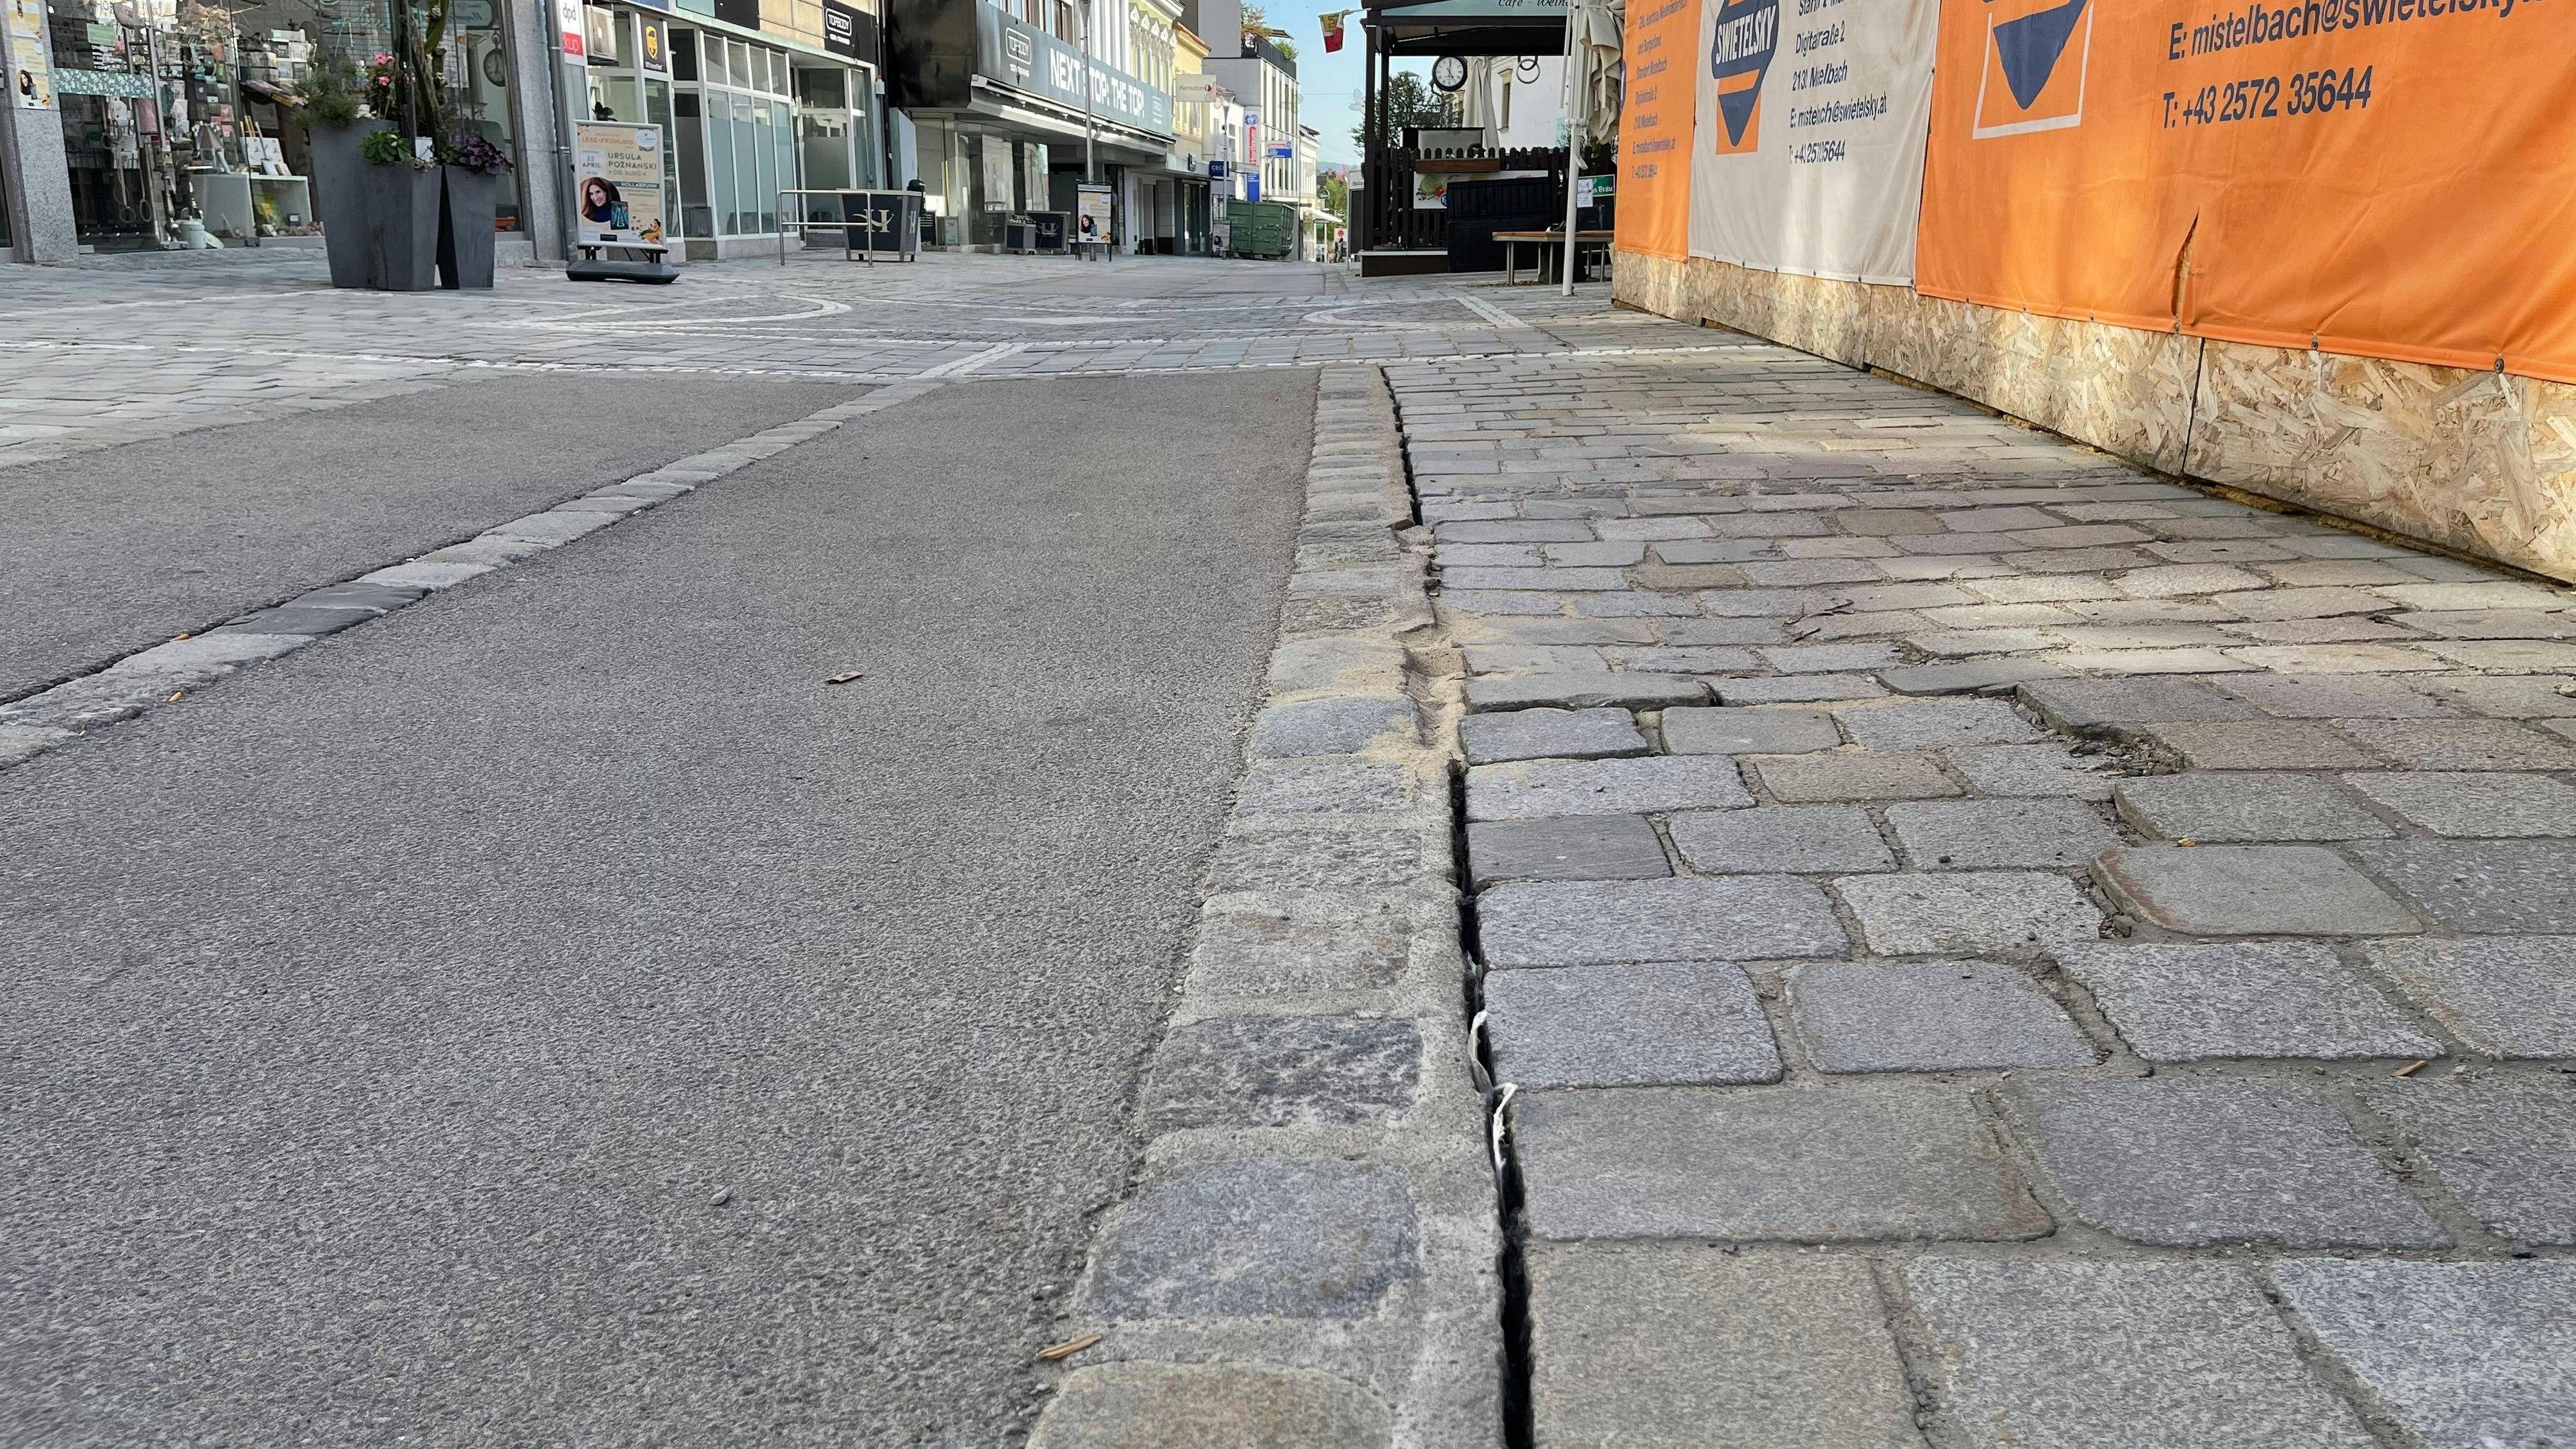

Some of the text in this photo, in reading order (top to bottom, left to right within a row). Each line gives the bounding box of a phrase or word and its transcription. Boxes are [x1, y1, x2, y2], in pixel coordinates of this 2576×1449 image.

[562, 3, 576, 23] dpd
[1716, 5, 1777, 65] SWIETELSKY
[1840, 20, 1845, 42] 2
[2168, 21, 2186, 61] E:
[1050, 48, 1080, 95] NEXT
[1111, 77, 1127, 112] THE
[1128, 84, 1144, 118] TOP!
[2163, 65, 2373, 129] T: +43 2572 35644
[1790, 108, 1796, 128] E:
[608, 152, 642, 160] URSULA
[609, 161, 657, 170] POZNANSKI
